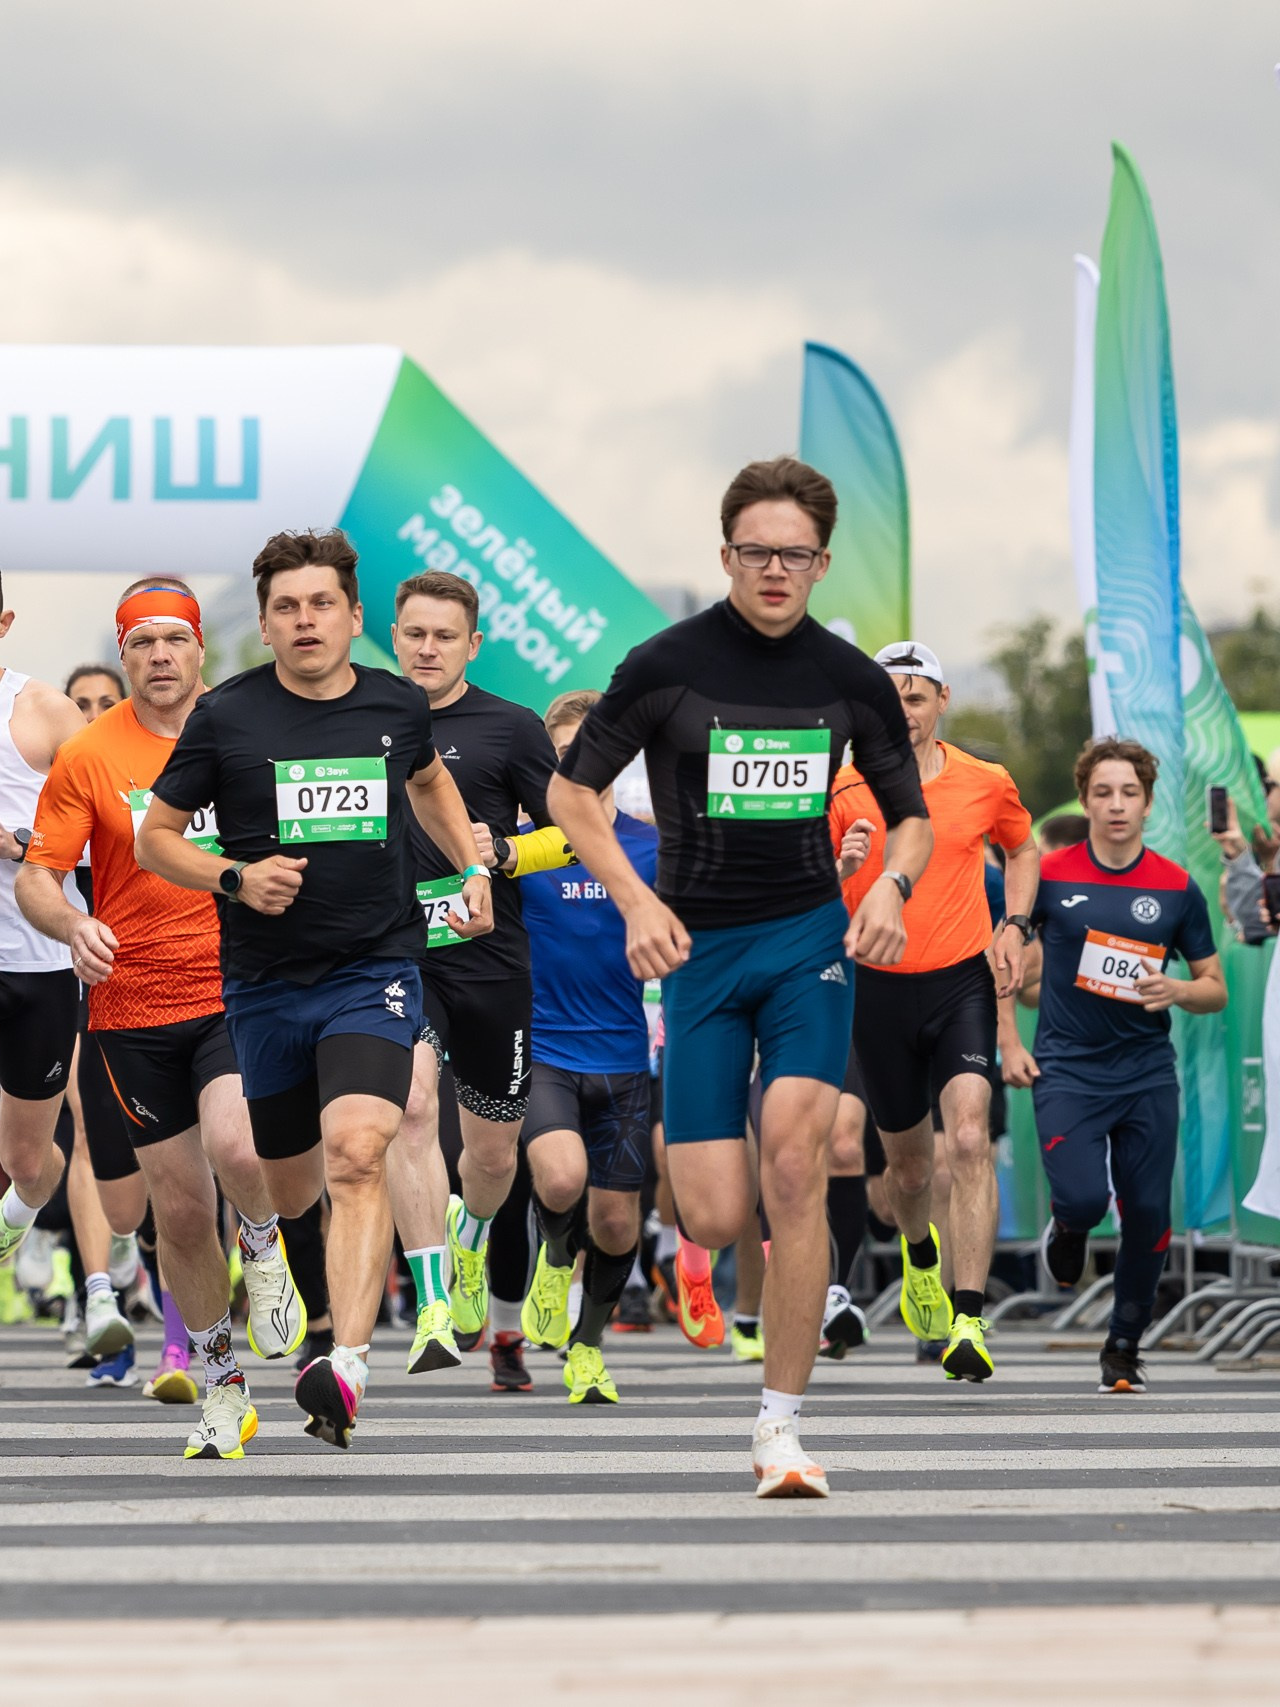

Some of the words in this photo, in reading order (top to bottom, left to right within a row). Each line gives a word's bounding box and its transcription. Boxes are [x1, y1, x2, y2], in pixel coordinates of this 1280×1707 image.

[429, 483, 608, 654] зелёный
[326, 767, 349, 777] Звук
[732, 760, 809, 788] 0705
[297, 785, 369, 813] 0723
[718, 794, 736, 815] A
[289, 821, 305, 839] A
